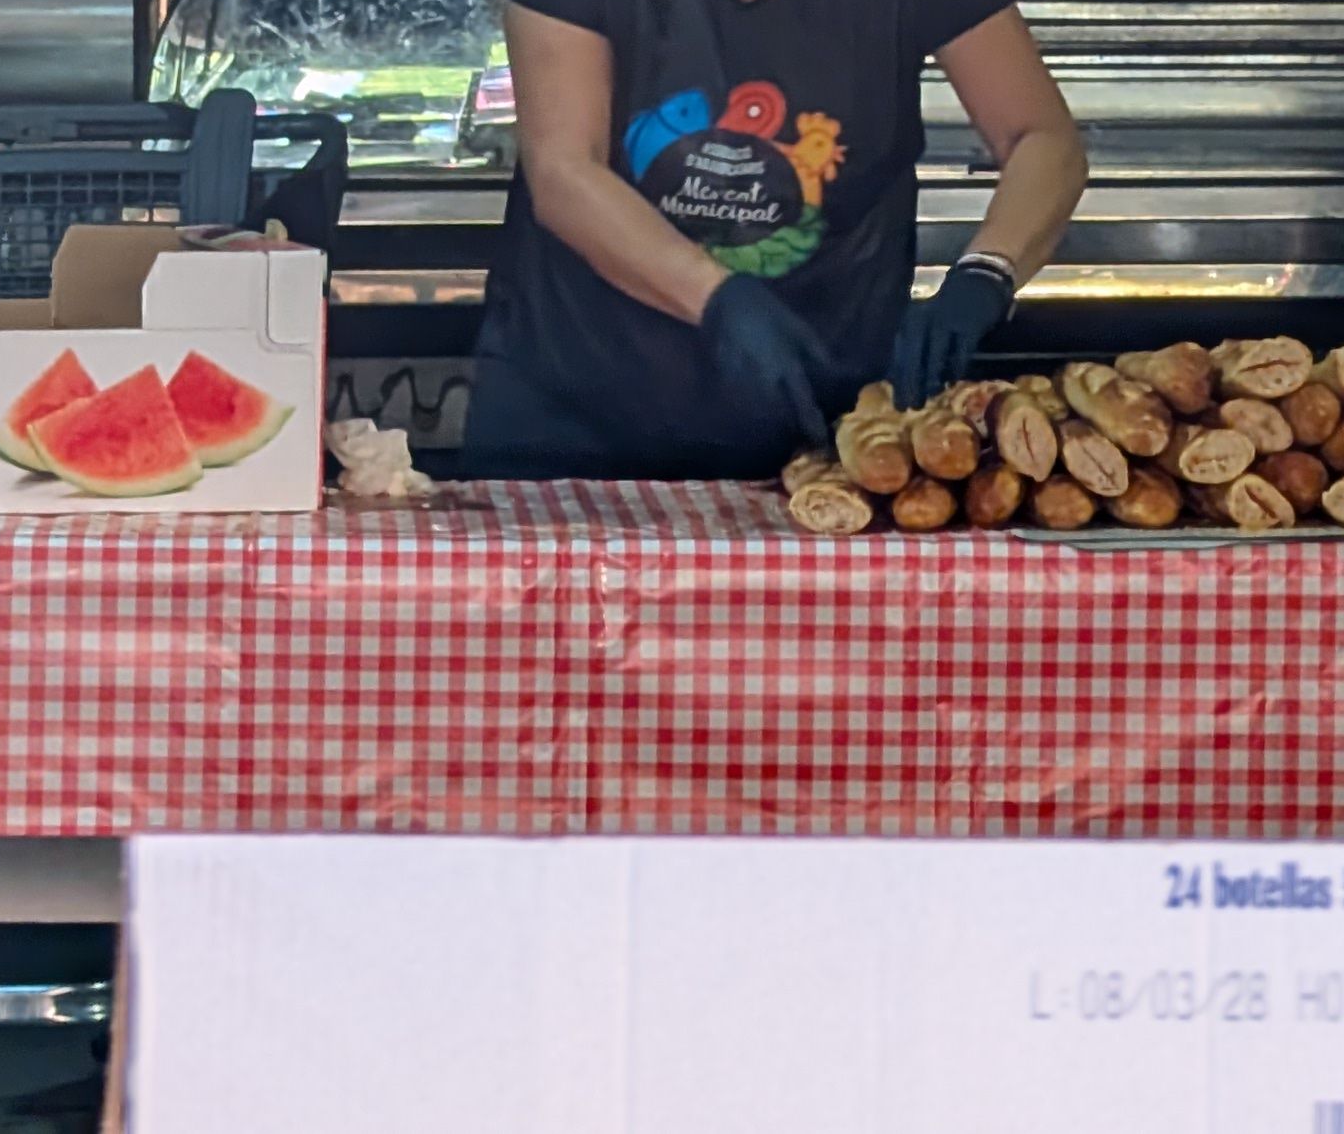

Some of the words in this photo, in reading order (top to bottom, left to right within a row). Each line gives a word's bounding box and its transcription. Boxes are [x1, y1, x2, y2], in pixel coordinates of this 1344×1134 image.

[660, 195, 783, 223] Municipal
[1164, 863, 1202, 909] 24
[1213, 860, 1332, 909] botellas
